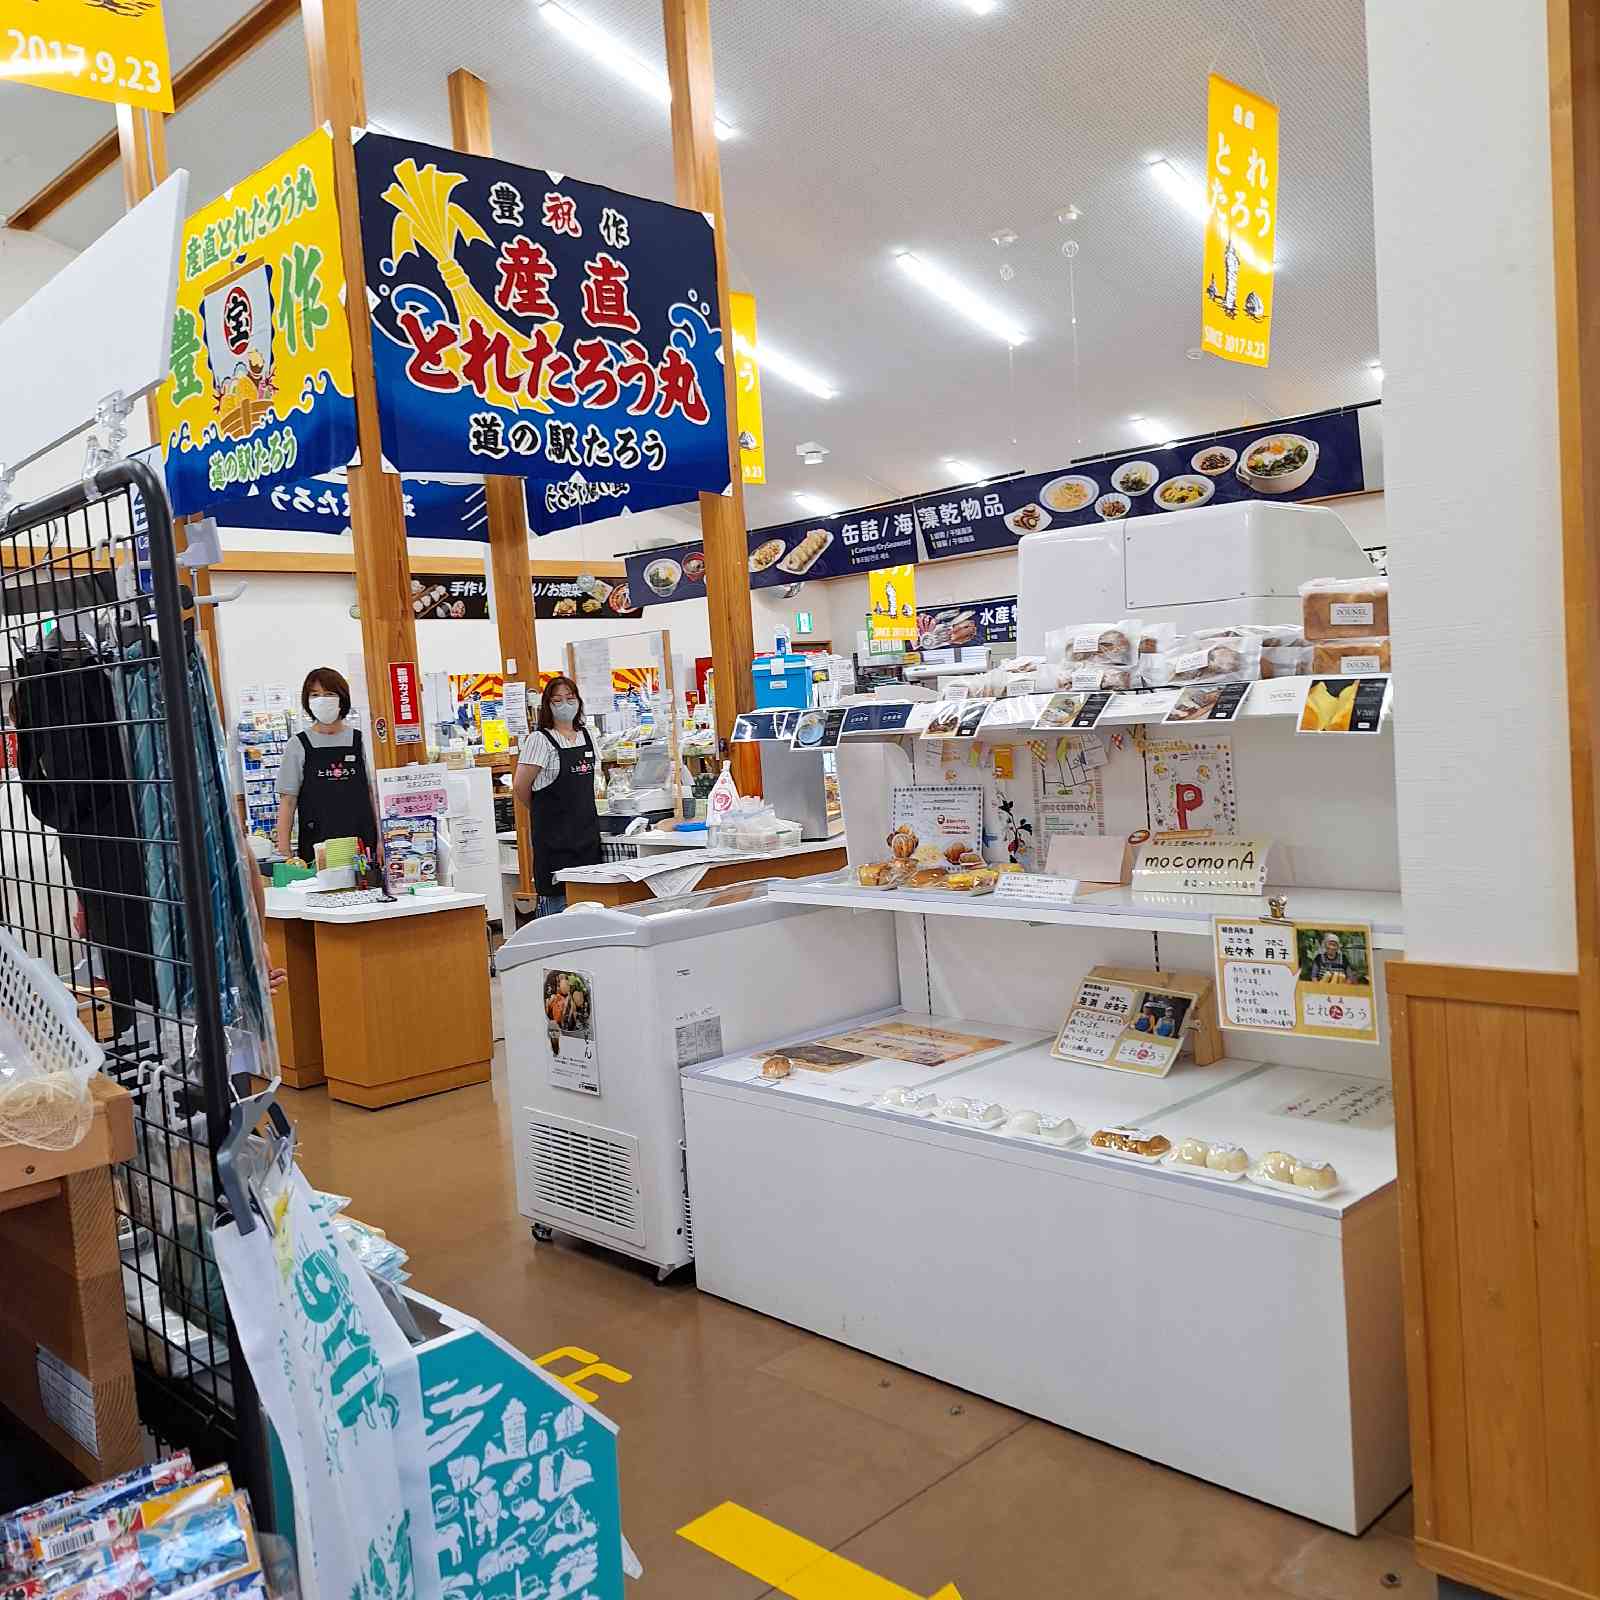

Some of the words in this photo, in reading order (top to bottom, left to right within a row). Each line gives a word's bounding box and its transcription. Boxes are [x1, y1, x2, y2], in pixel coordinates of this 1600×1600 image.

[7, 28, 162, 93] 2017.9.23
[186, 165, 318, 281] 産直とれたろう丸
[490, 182, 524, 227] 豊
[543, 192, 582, 237] 祝
[599, 207, 630, 248] 作
[496, 235, 641, 334] 産直
[170, 307, 204, 408] 豊
[278, 241, 329, 357] 作
[400, 312, 710, 425] とれたろう丸
[208, 425, 298, 491] 道の駅たろう
[469, 412, 666, 470] 道の駅たろう
[1144, 850, 1255, 872] mocomonA
[1224, 946, 1255, 958] 佐々木
